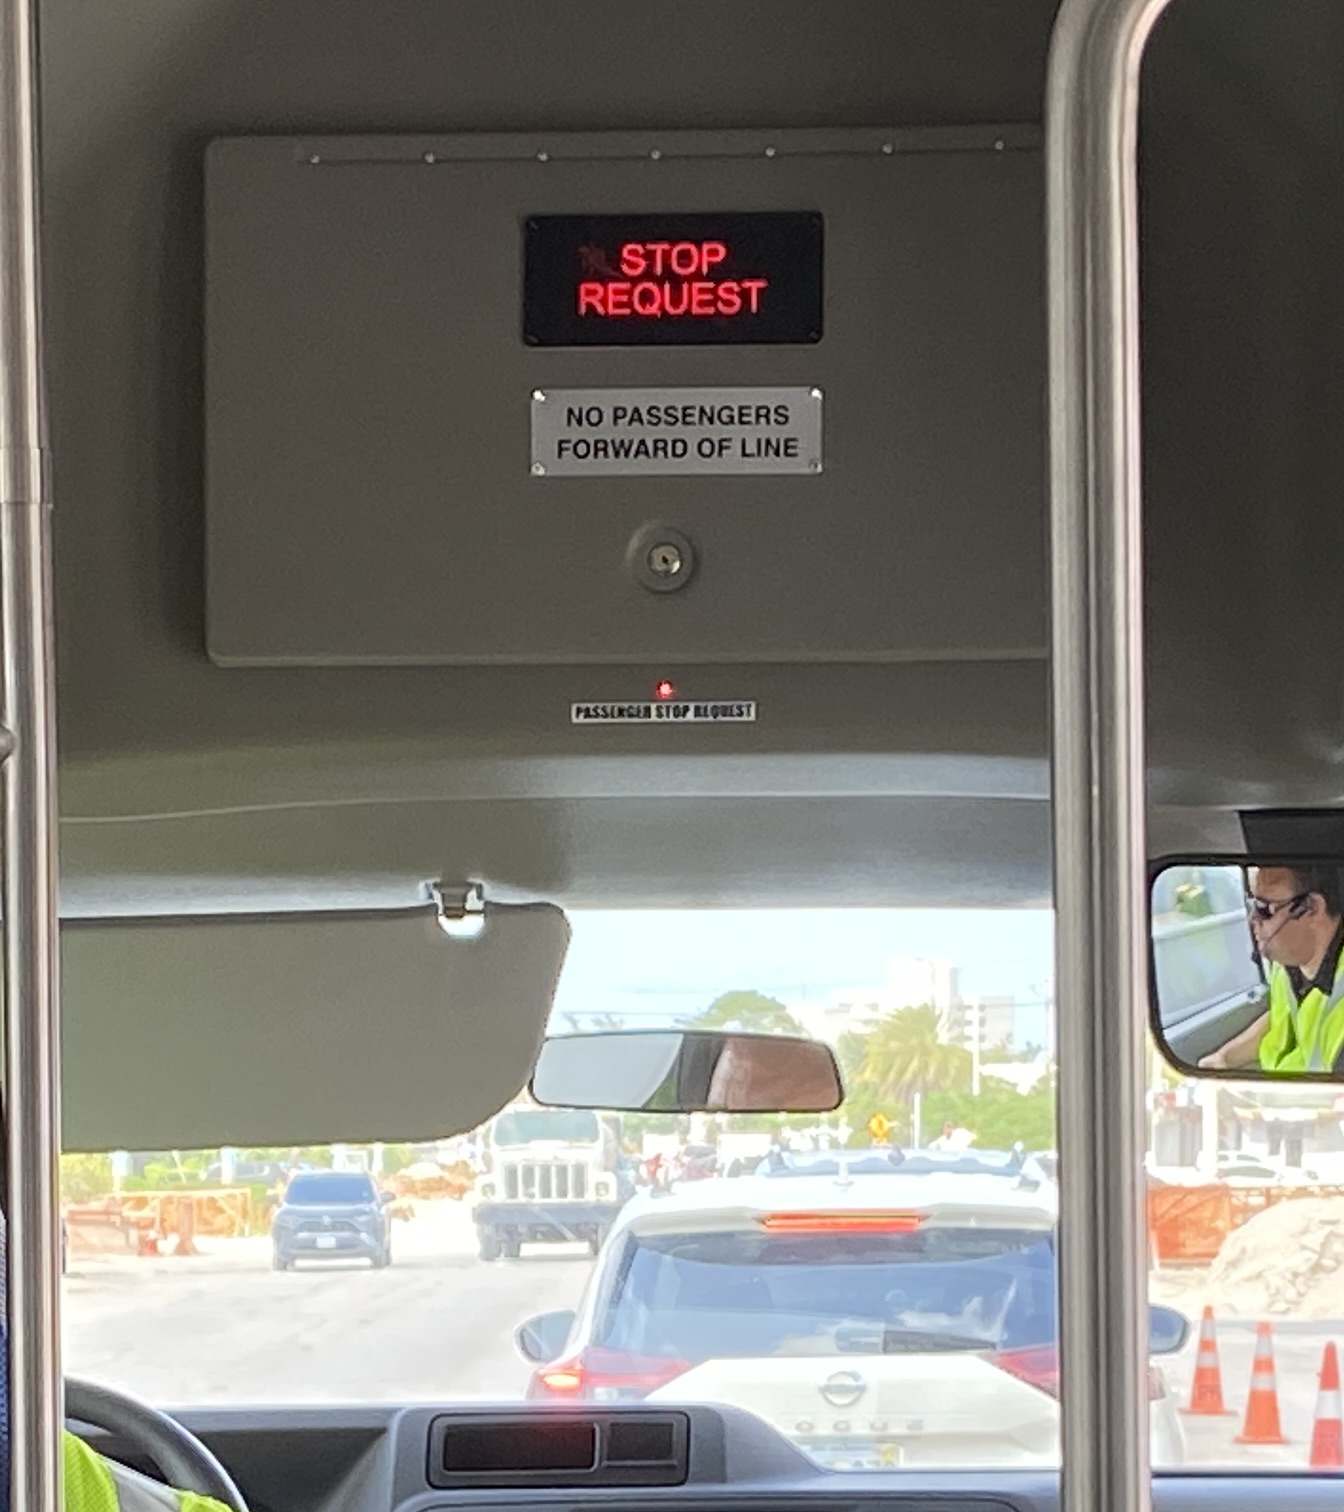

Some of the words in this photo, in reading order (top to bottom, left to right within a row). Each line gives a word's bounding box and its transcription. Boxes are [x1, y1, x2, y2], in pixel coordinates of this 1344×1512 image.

[621, 241, 727, 276] STOP
[577, 279, 768, 317] REQUEST
[566, 406, 604, 428] NO
[613, 405, 790, 427] PASSENGERS
[557, 438, 688, 460] FORWARD
[697, 438, 732, 458] OF
[741, 437, 799, 458] LINE
[575, 705, 652, 720] PASSENGER
[656, 705, 690, 719] STOP
[694, 703, 753, 719] REQUEST
